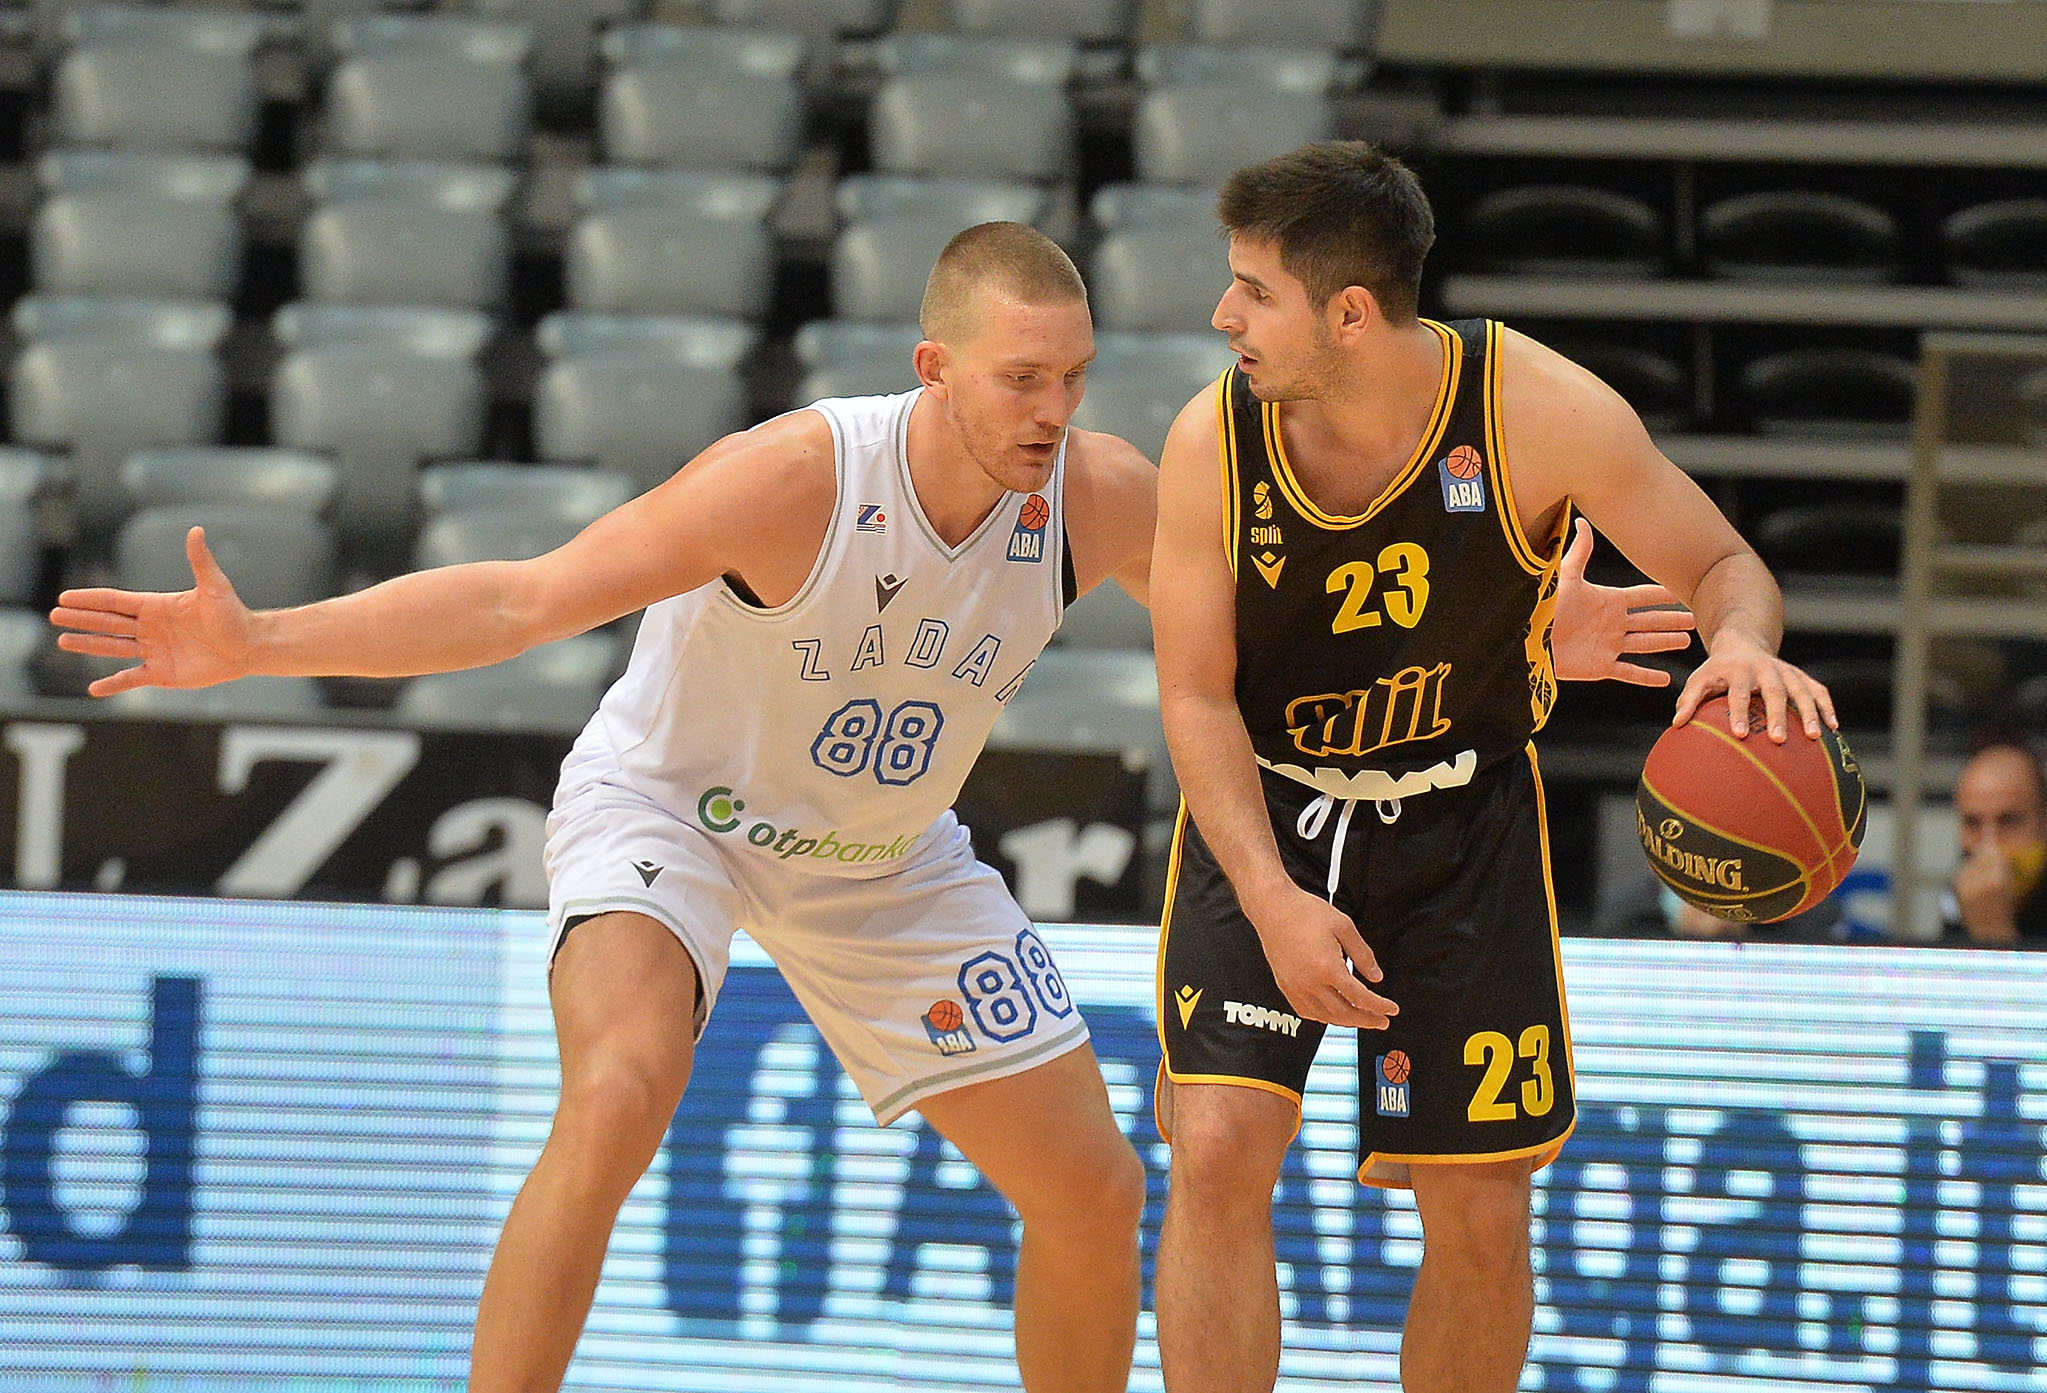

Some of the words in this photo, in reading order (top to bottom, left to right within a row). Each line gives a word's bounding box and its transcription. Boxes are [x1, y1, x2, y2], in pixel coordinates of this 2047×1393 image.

[1449, 482, 1482, 507] ABA
[1008, 532, 1041, 559] ABA
[1250, 524, 1284, 545] split
[1326, 541, 1430, 634] 23
[810, 699, 945, 786] 88
[957, 928, 1073, 1044] 88
[1223, 1001, 1302, 1038] TOMMY
[1463, 1024, 1554, 1122] 23
[1380, 1086, 1408, 1113] ABA
